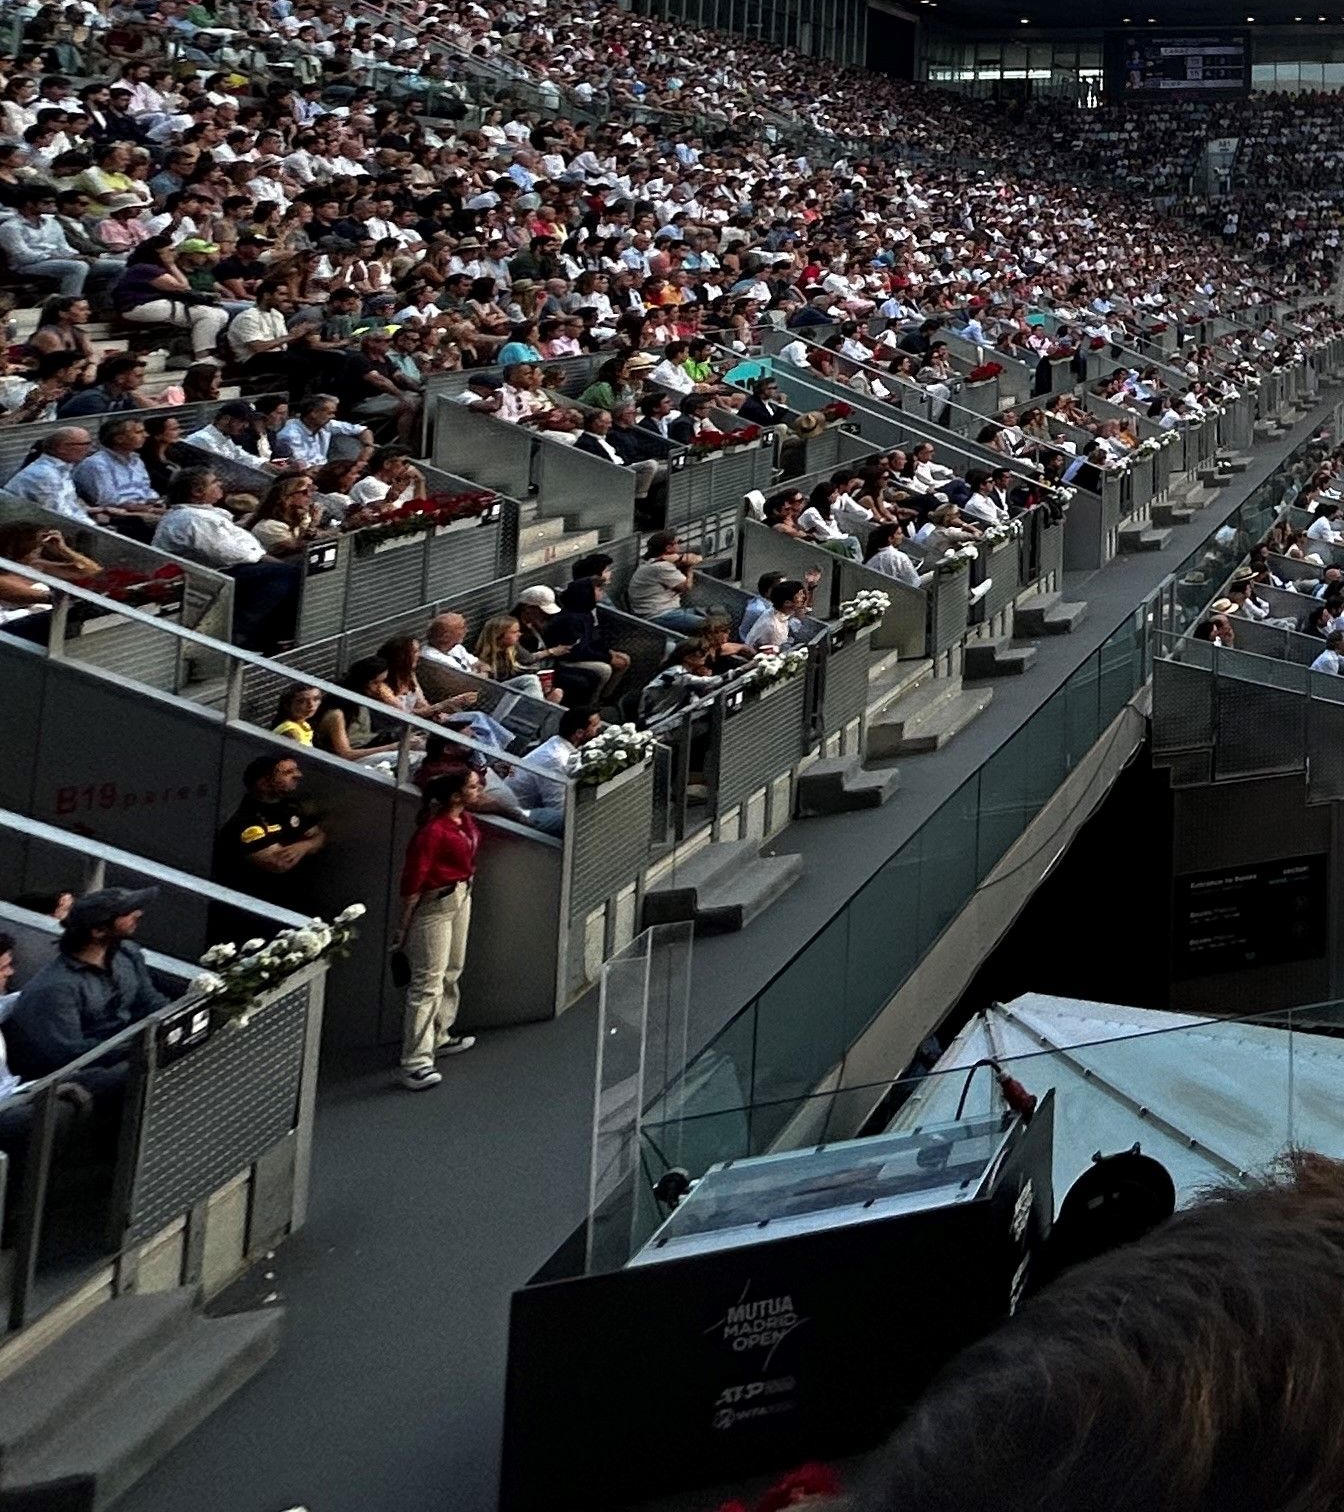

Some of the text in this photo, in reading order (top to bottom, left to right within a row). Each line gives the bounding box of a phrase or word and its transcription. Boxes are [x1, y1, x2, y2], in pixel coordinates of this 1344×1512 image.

[727, 1294, 795, 1325] MUTUA
[722, 1312, 799, 1341] MADRID
[731, 1330, 788, 1352] OPEN
